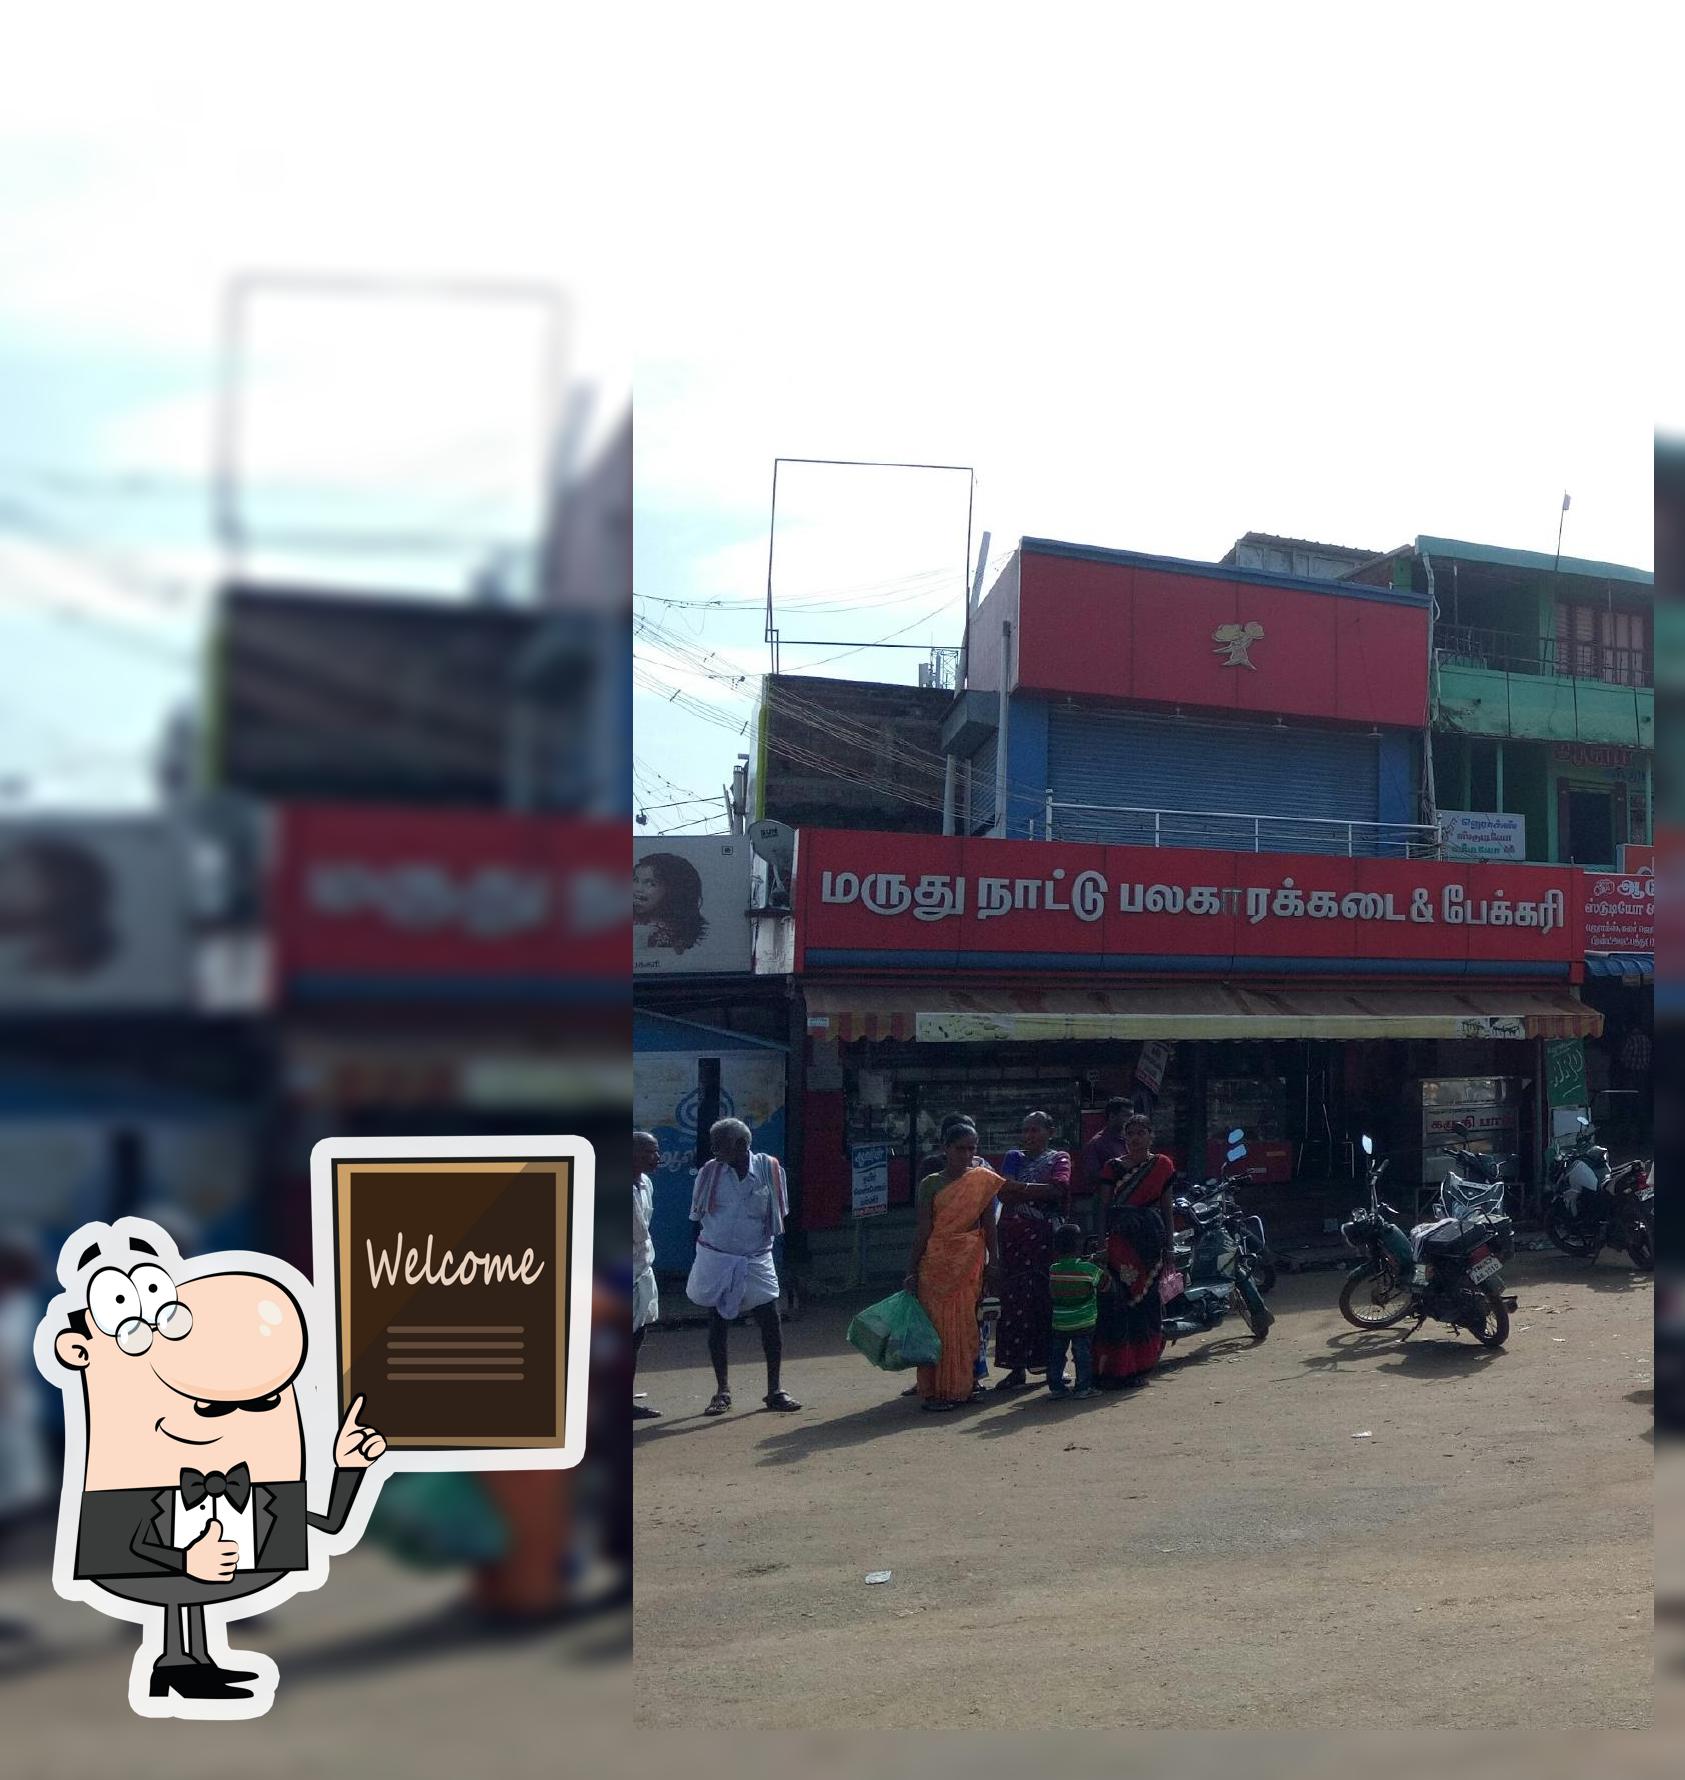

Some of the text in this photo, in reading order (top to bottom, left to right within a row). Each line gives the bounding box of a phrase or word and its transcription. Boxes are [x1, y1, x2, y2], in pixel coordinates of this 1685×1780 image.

[821, 868, 1565, 934] மருது நாட்டு பலகாரக்கடை & பேக்கரி
